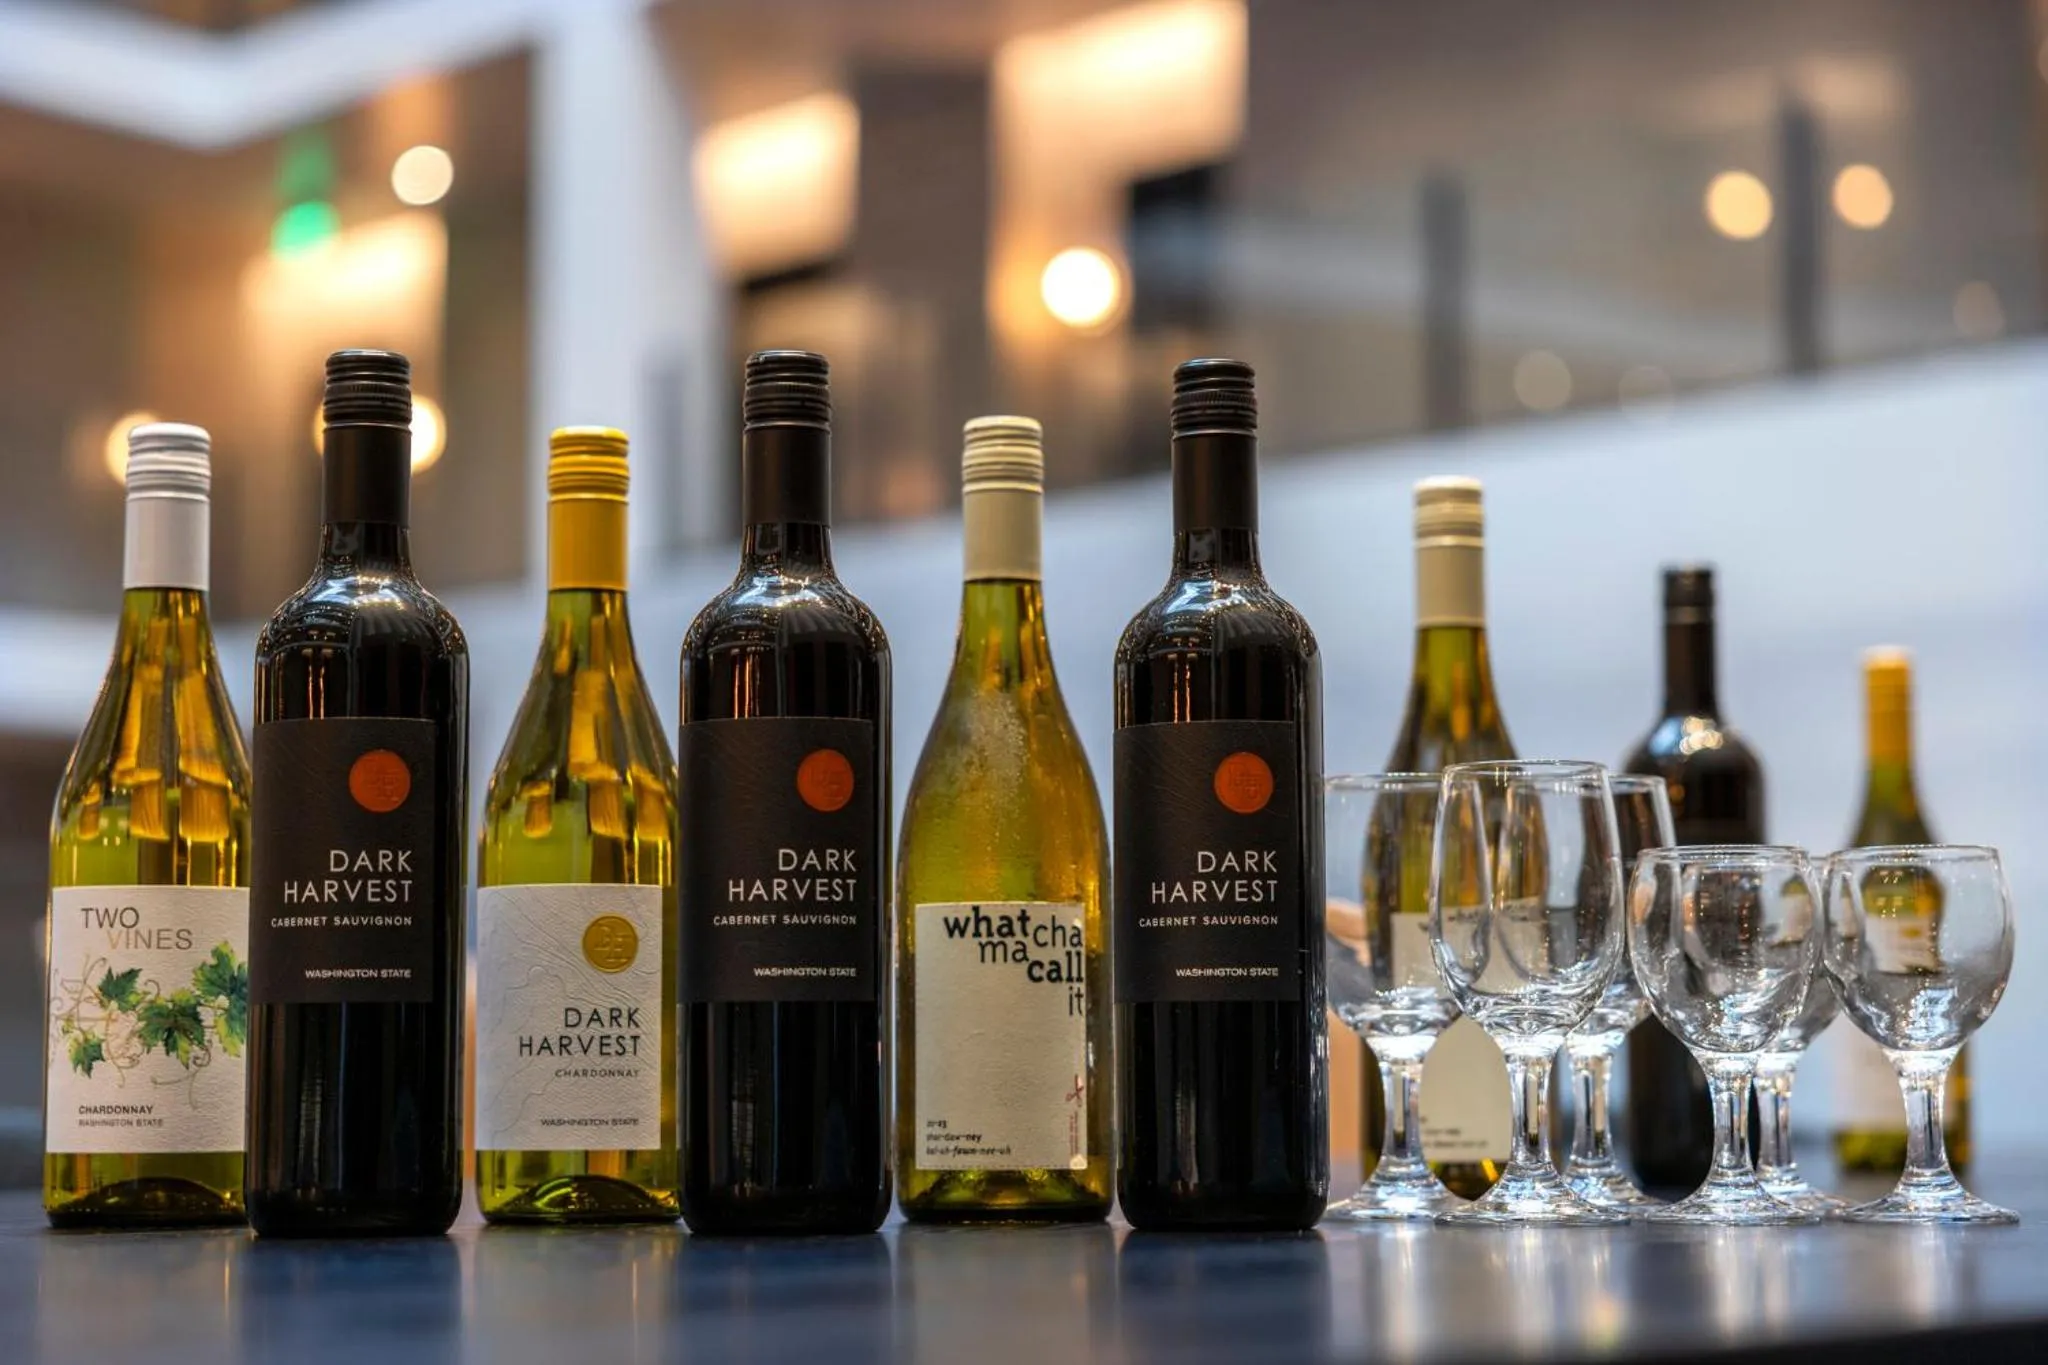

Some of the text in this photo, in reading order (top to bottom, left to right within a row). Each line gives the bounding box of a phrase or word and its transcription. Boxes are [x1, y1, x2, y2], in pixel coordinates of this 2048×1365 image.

[329, 850, 412, 873] DARK
[778, 849, 856, 872] DARK
[1197, 851, 1277, 873] DARK
[284, 880, 413, 904] HARVEST
[728, 879, 857, 902] HARVEST
[1151, 880, 1278, 904] HARVEST
[80, 906, 140, 929] TWO
[271, 915, 412, 928] CABERNET SAUVIGNON
[713, 914, 857, 926] CABERNET SAUVIGNON
[943, 906, 1083, 948] what cha
[1139, 915, 1278, 928] CABERNET SAUVIGNON
[107, 928, 194, 950] VINES
[979, 940, 1029, 963] ma
[305, 968, 411, 979] WASHINGTON STATE
[753, 967, 857, 977] WASHINGTON STATE
[1027, 951, 1084, 983] call
[1175, 967, 1279, 977] WASHINGTON STATE
[1069, 986, 1084, 1015] it
[564, 1008, 641, 1029] DARK
[519, 1035, 641, 1057] HARVEST
[554, 1068, 639, 1078] CHARDONNAY
[78, 1105, 154, 1115] CHARDONNAY
[540, 1117, 639, 1127] WASHINGTON STATE
